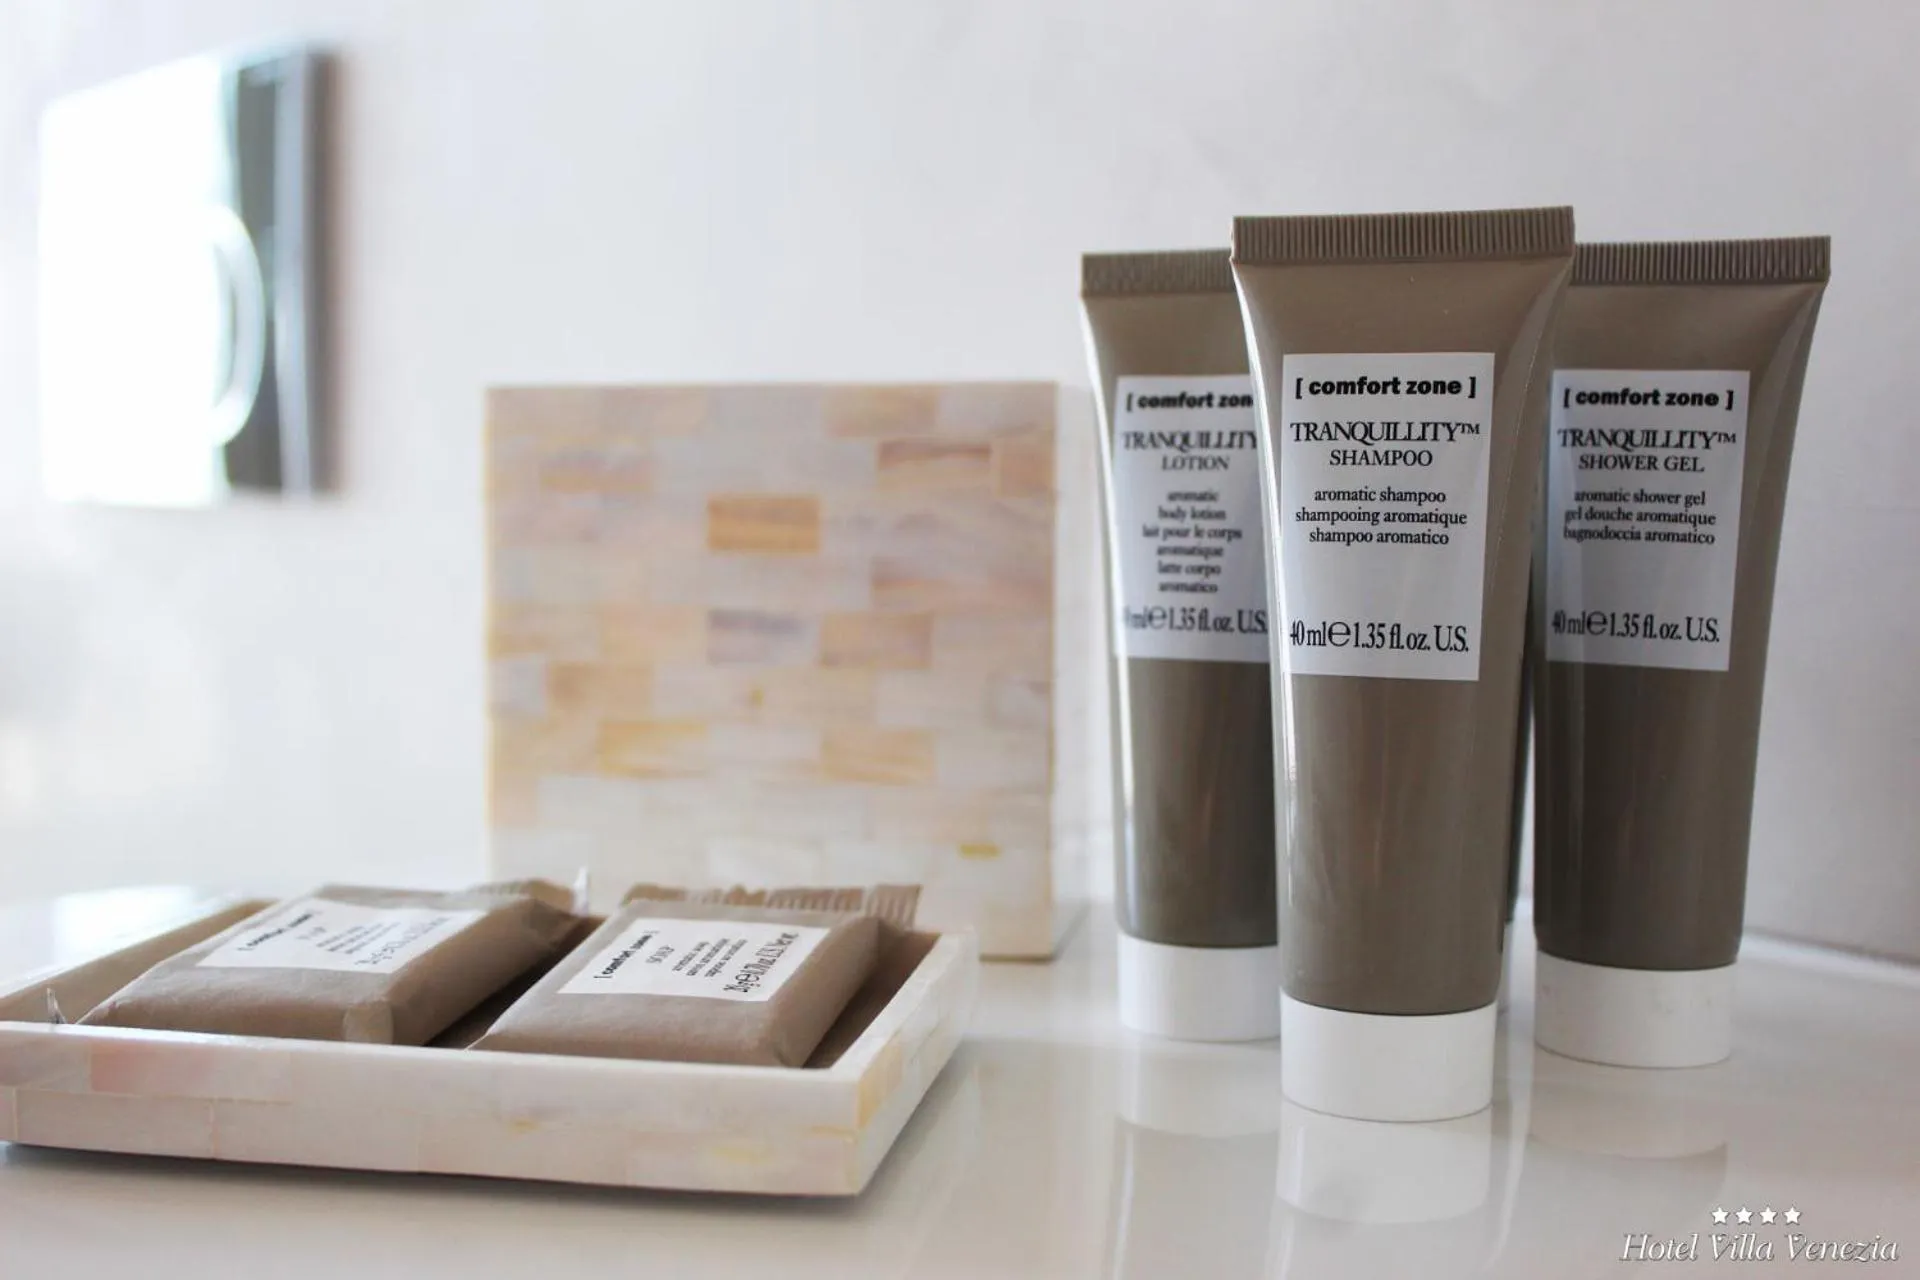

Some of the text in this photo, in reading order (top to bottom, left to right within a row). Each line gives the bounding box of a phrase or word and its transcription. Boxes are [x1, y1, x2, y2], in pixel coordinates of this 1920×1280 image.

[1308, 376, 1400, 395] comfort
[1406, 378, 1462, 395] zone
[1137, 391, 1214, 409] comfort
[1218, 393, 1254, 408] zon
[1575, 388, 1660, 406] comfort
[1665, 391, 1720, 407] zone
[1122, 430, 1257, 453] TRANQUILLITY
[1161, 454, 1230, 471] LOTION
[1329, 450, 1433, 467] SHAMPOO
[1578, 455, 1705, 473] SHOWER GEL
[1314, 486, 1446, 506] aromatic shampoo
[1574, 488, 1706, 508] aromatic shower gel
[1295, 507, 1467, 530] shampooing aromatique
[1585, 506, 1633, 522] douche
[1636, 508, 1717, 529] aromatique
[1309, 528, 1449, 547] shampoo aromatico
[1645, 528, 1715, 545] aromatico
[1406, 631, 1430, 651] oz.
[1433, 624, 1469, 652] U.S.
